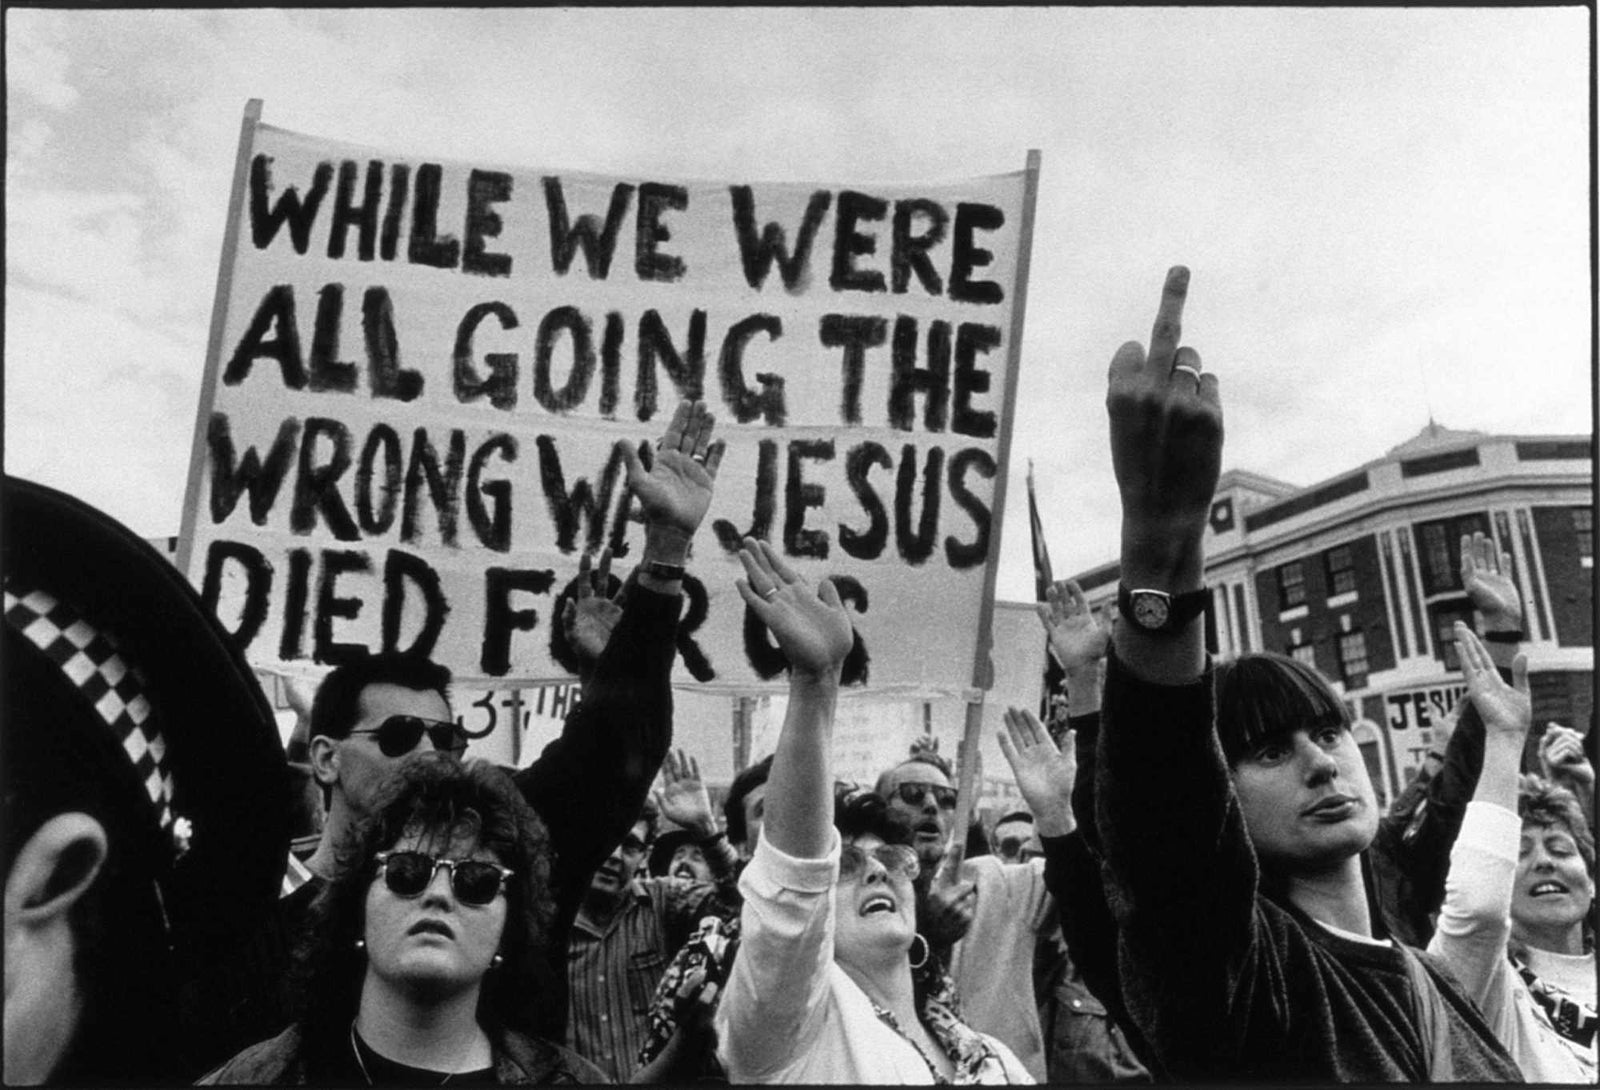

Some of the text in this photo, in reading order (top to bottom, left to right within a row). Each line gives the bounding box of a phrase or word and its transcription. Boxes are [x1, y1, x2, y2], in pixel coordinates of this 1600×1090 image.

[250, 153, 1005, 304] WHILE WE WERE
[223, 282, 1002, 438] ALL GOING THE
[207, 411, 519, 554] WRONG
[713, 437, 998, 569] JESUS
[199, 539, 452, 666] DIED
